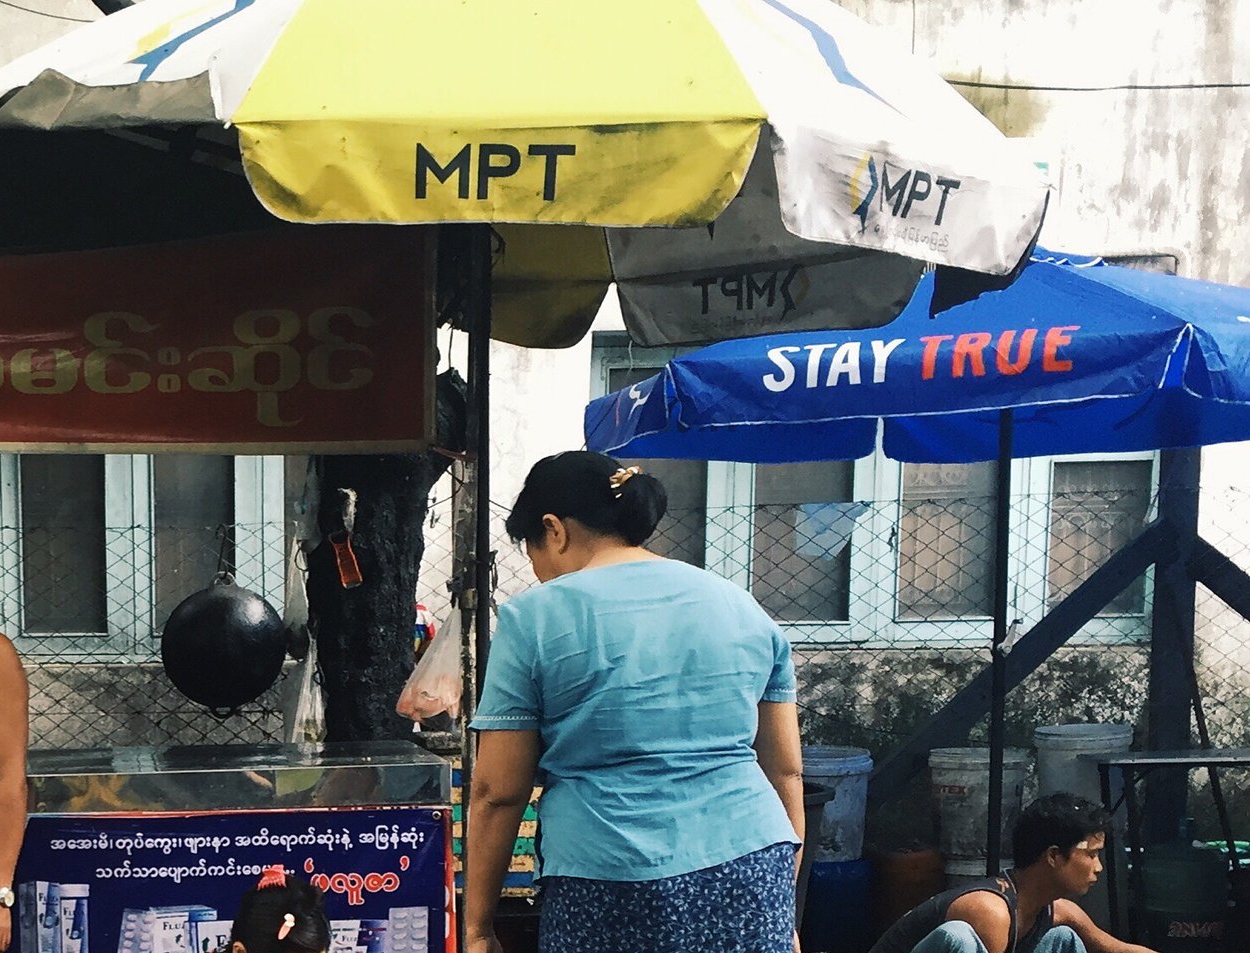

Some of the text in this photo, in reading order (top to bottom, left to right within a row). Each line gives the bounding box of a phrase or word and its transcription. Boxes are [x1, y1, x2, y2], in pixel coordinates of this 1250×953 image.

[415, 143, 576, 201] MPT
[879, 161, 961, 226] MPT
[763, 325, 1081, 393] STAY TRUE
